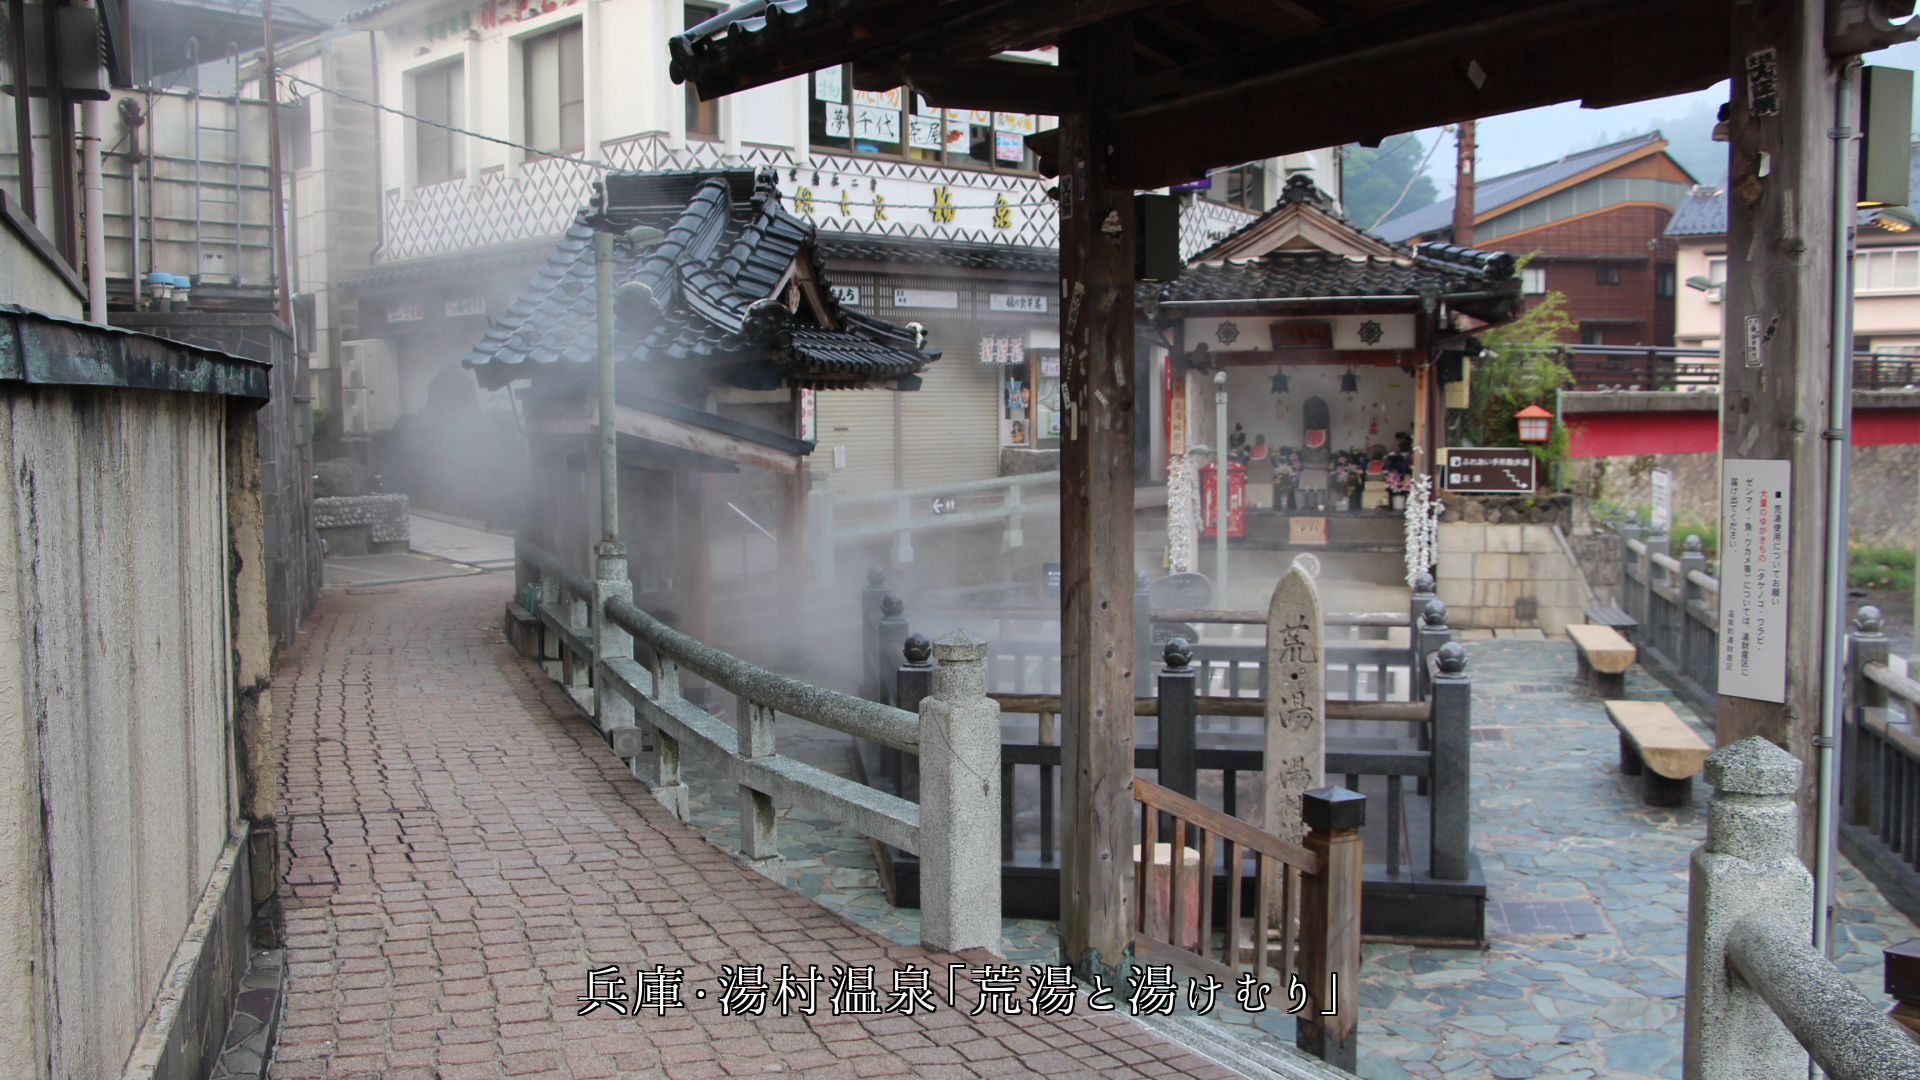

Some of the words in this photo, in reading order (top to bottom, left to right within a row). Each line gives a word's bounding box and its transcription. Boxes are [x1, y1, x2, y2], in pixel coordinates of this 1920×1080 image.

[829, 108, 943, 145] 夢千代茶屋
[1728, 477, 1739, 553] 届け出てください。
[1771, 504, 1784, 606] 荒湯使用についてお願い
[1278, 614, 1319, 731] 荒湯
